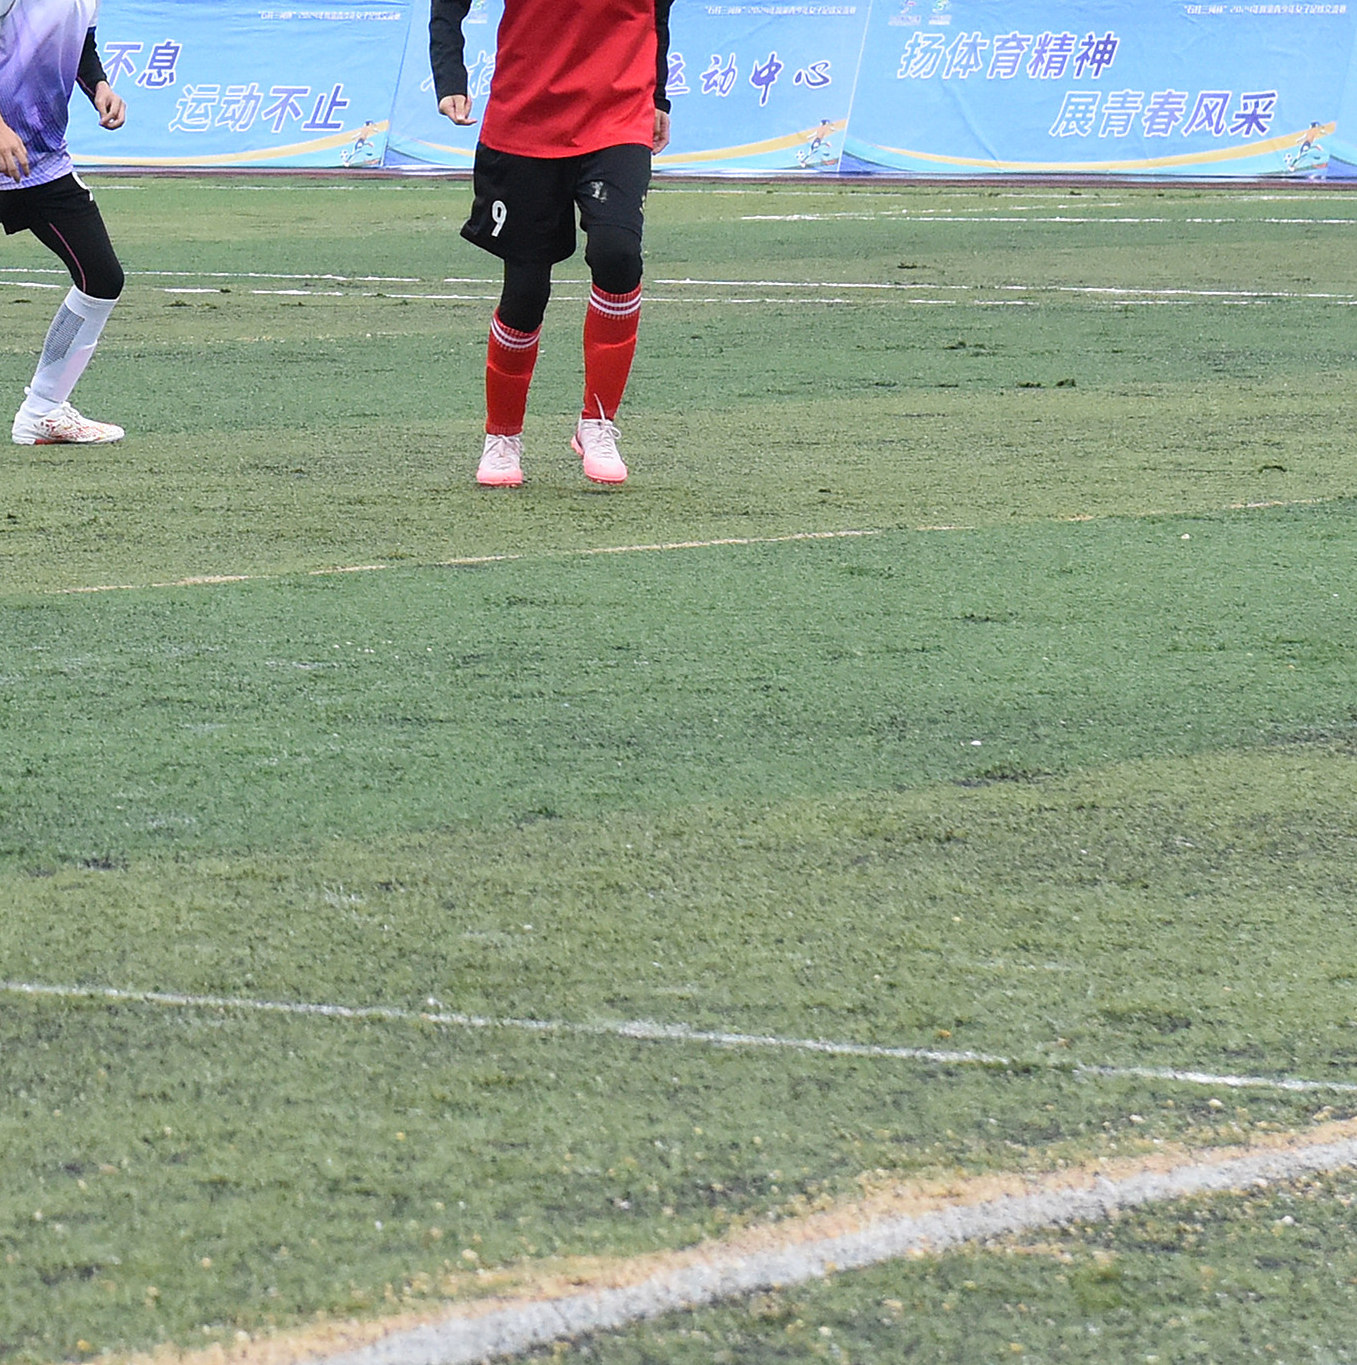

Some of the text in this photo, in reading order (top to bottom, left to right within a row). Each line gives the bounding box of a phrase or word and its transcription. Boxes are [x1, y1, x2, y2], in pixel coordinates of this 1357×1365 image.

[898, 31, 1120, 79] 扬体育精神
[169, 83, 349, 133] 运动不止
[1049, 89, 1278, 137] 展青春风采
[491, 200, 507, 237] 9
